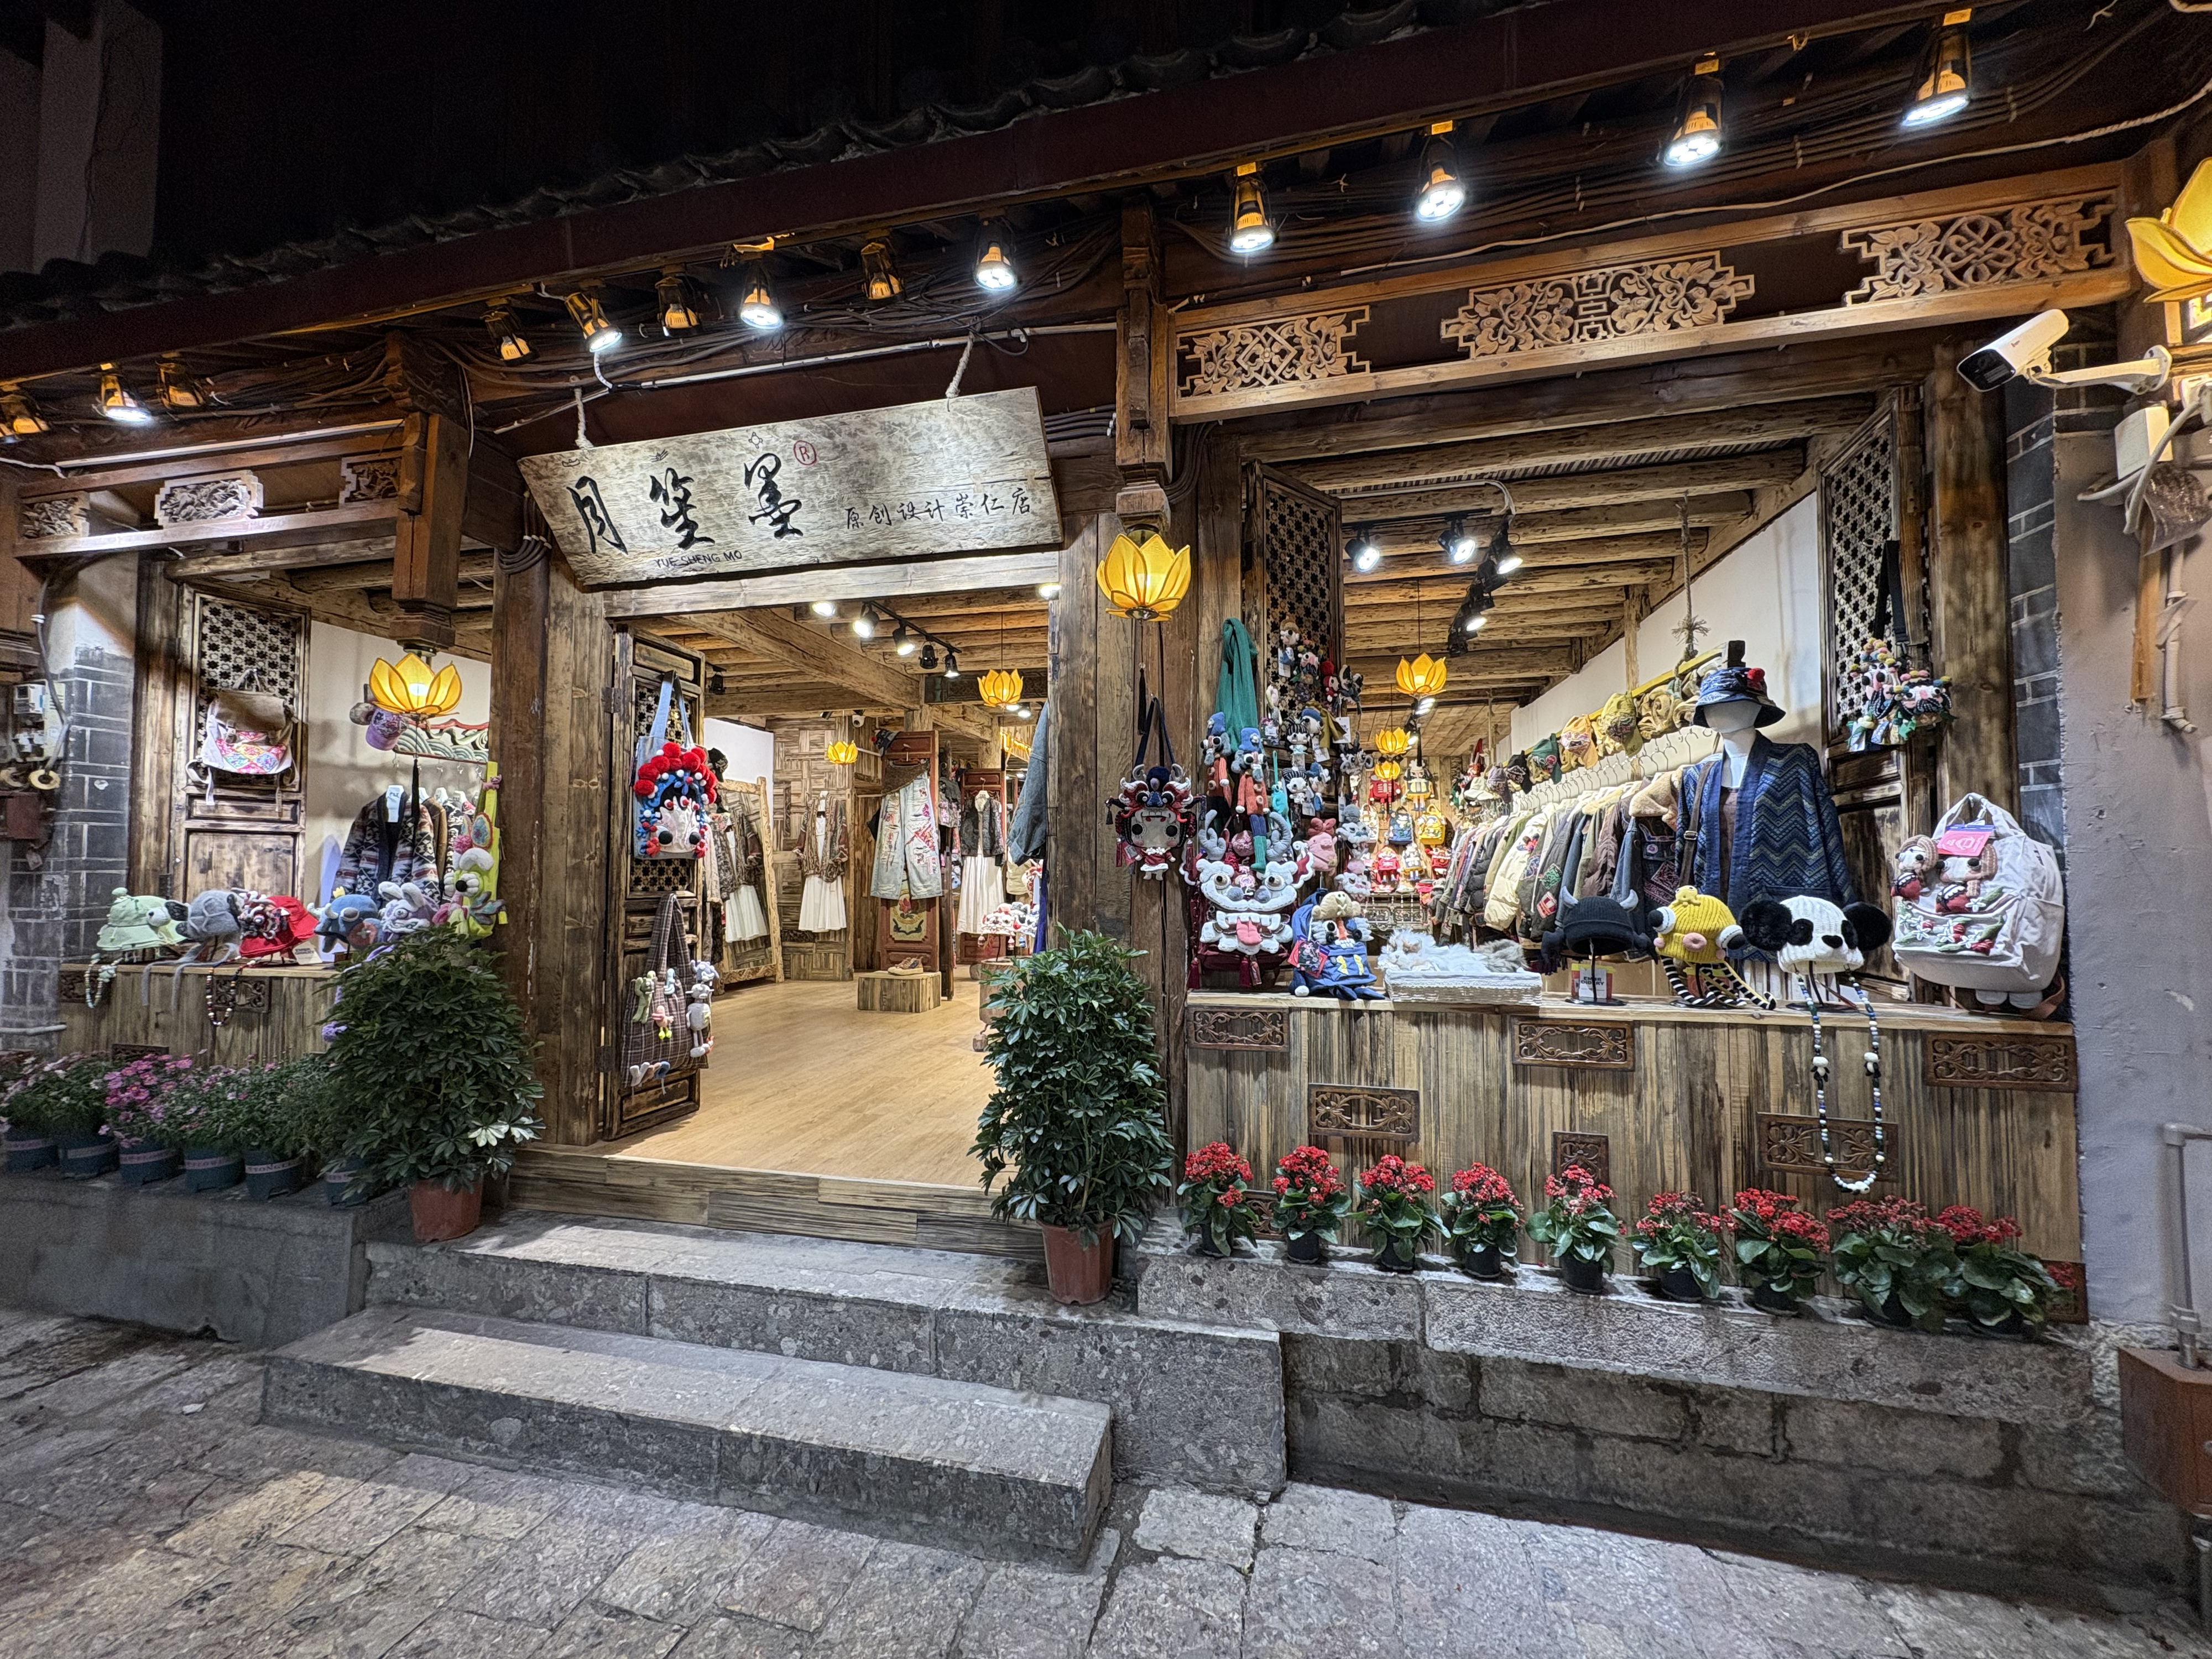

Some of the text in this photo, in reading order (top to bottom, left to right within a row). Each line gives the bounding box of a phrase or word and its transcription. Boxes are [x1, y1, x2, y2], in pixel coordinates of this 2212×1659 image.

[566, 452, 804, 555] 月笙墨
[844, 487, 1031, 530] 原创设计崇仁店
[654, 550, 743, 568] YUE SHENG MO
